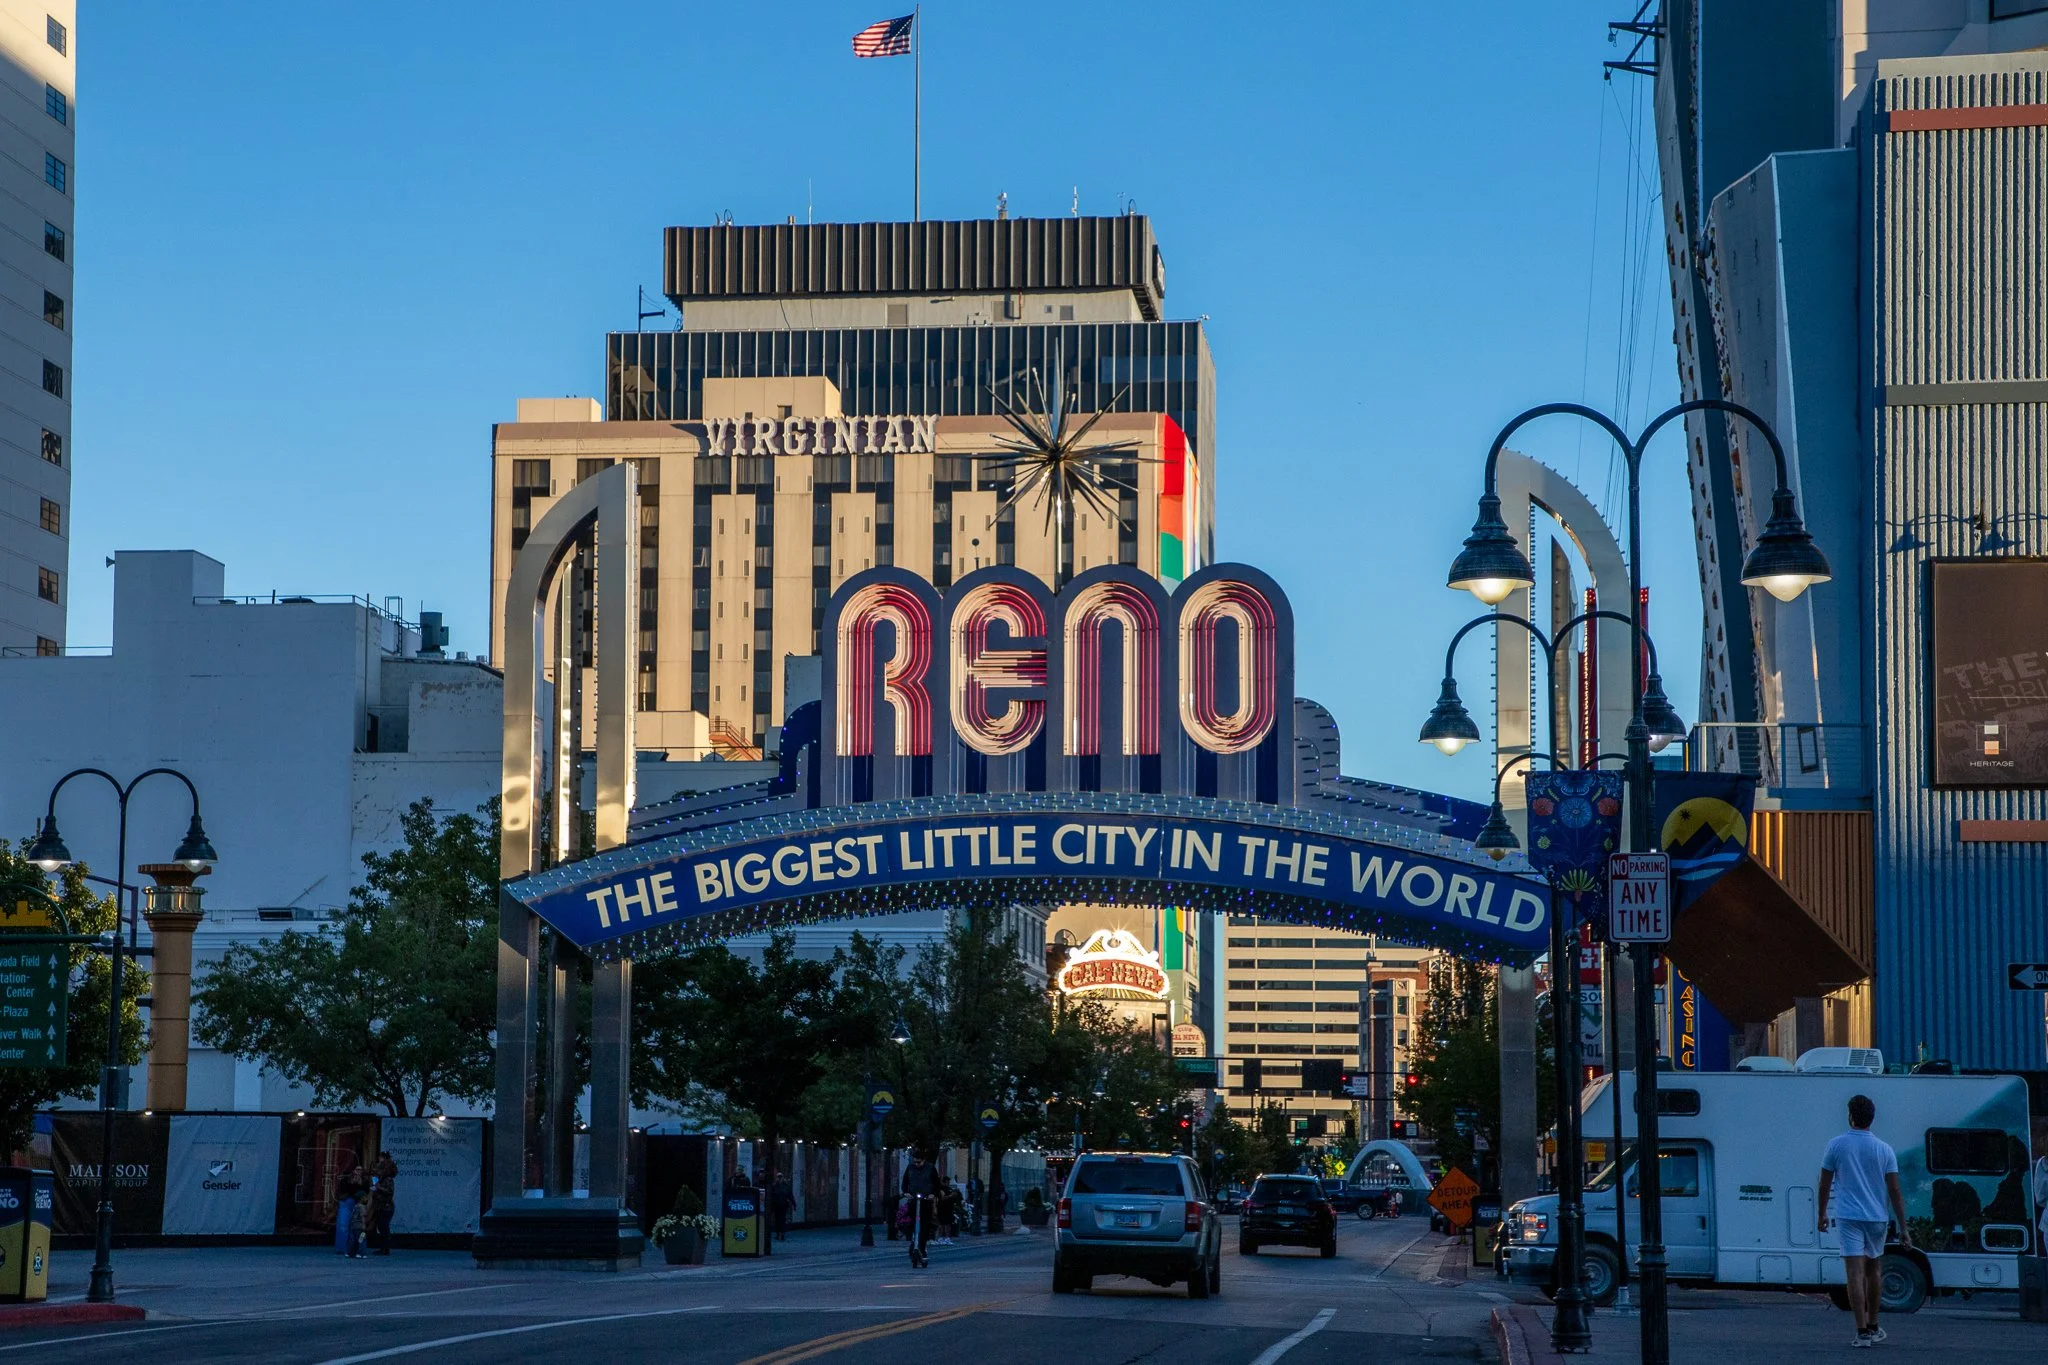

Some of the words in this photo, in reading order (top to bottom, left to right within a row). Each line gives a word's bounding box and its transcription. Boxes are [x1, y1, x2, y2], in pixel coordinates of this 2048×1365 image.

[703, 413, 940, 456] VIRGINIAN
[836, 579, 1276, 756] RENO
[1969, 760, 2015, 768] HERITAGE
[1612, 859, 1628, 875] NO
[1629, 861, 1666, 873] PARKING
[586, 871, 678, 929] THE
[694, 835, 884, 903] BIGGEST
[901, 825, 1036, 871] LITTLE
[1052, 823, 1157, 867] CITY
[1169, 828, 1221, 872] IN
[1237, 835, 1332, 887] THE
[1350, 851, 1546, 933] WORLD
[1621, 882, 1658, 904] ANY
[1618, 910, 1662, 933] TIME
[21, 955, 40, 967] Field
[6, 986, 35, 998] Center
[21, 1027, 42, 1040] Walk
[388, 1125, 395, 1133] A
[388, 1136, 406, 1145] next
[408, 1137, 421, 1145] era
[423, 1136, 432, 1145] of
[426, 1158, 440, 1166] and
[114, 1180, 149, 1188] GROUP
[202, 1180, 242, 1190] Gensler
[1437, 1185, 1478, 1197] DETOUR
